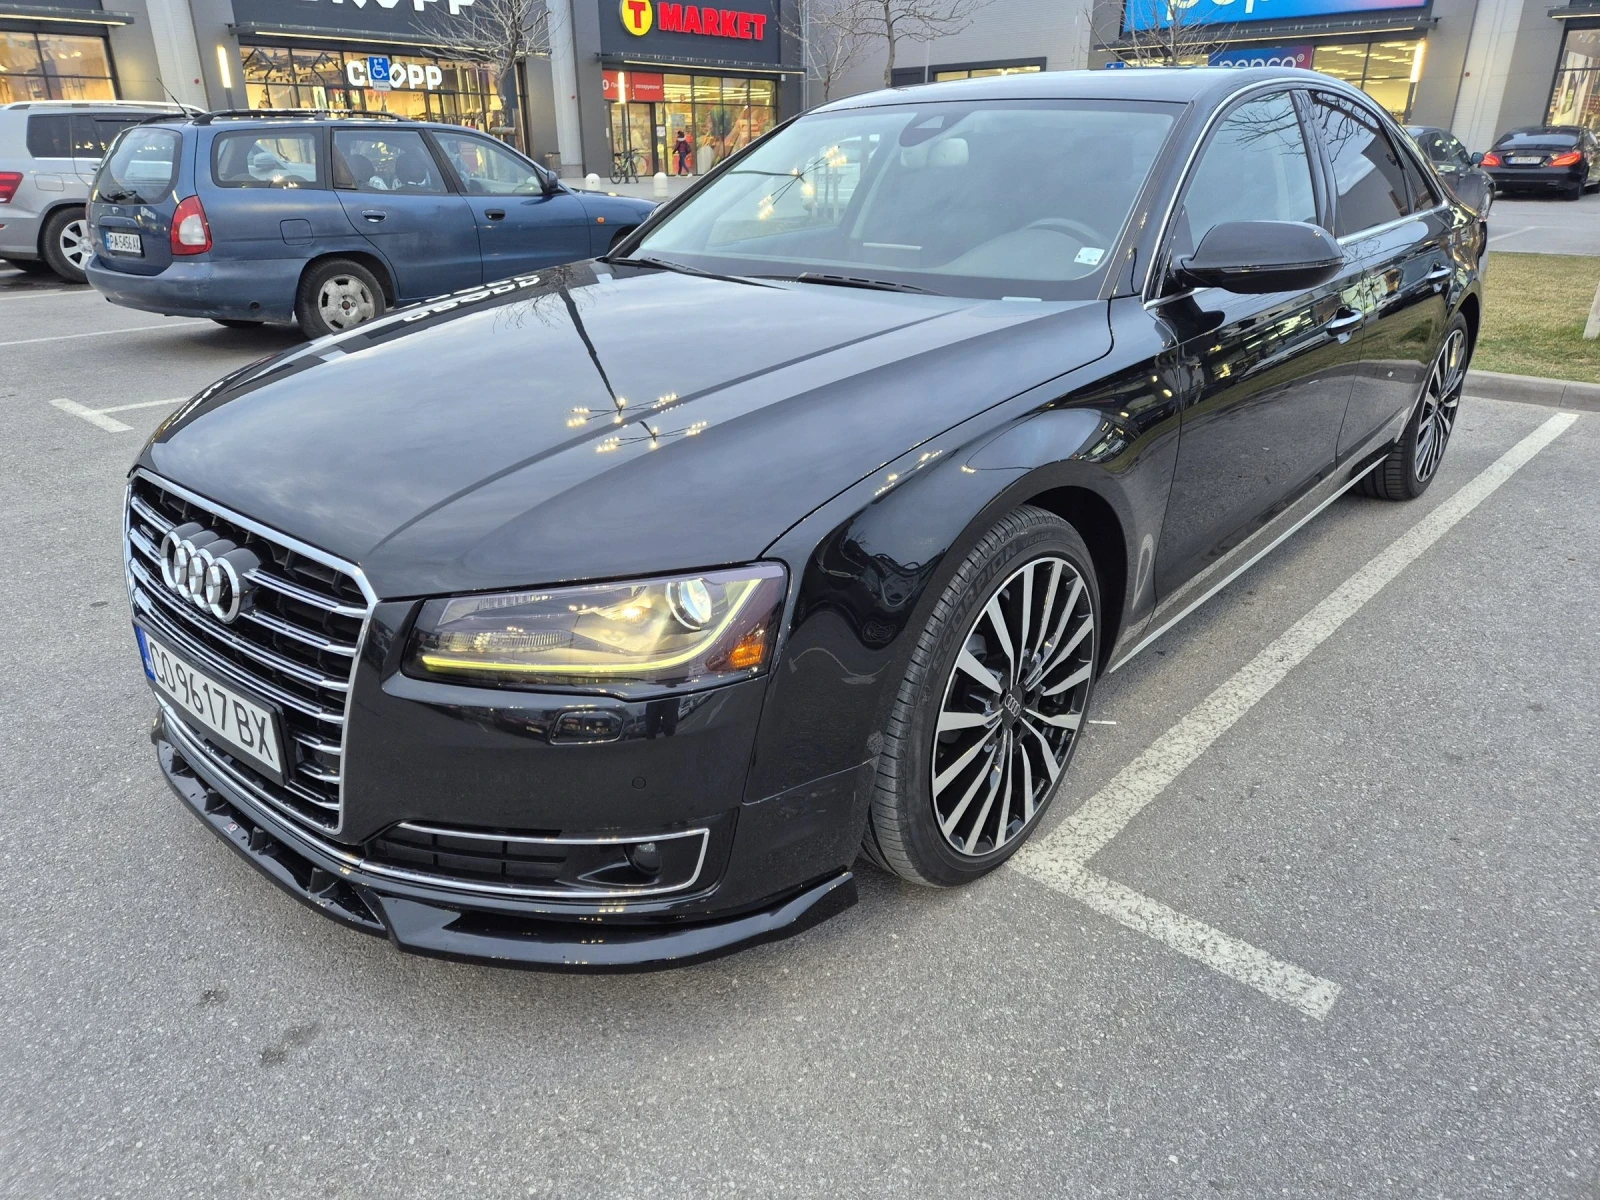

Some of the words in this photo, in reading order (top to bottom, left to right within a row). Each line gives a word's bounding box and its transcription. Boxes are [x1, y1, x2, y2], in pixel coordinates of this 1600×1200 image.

[627, 1, 647, 29] T
[658, 2, 767, 41] MARKET
[346, 60, 443, 91] COPP
